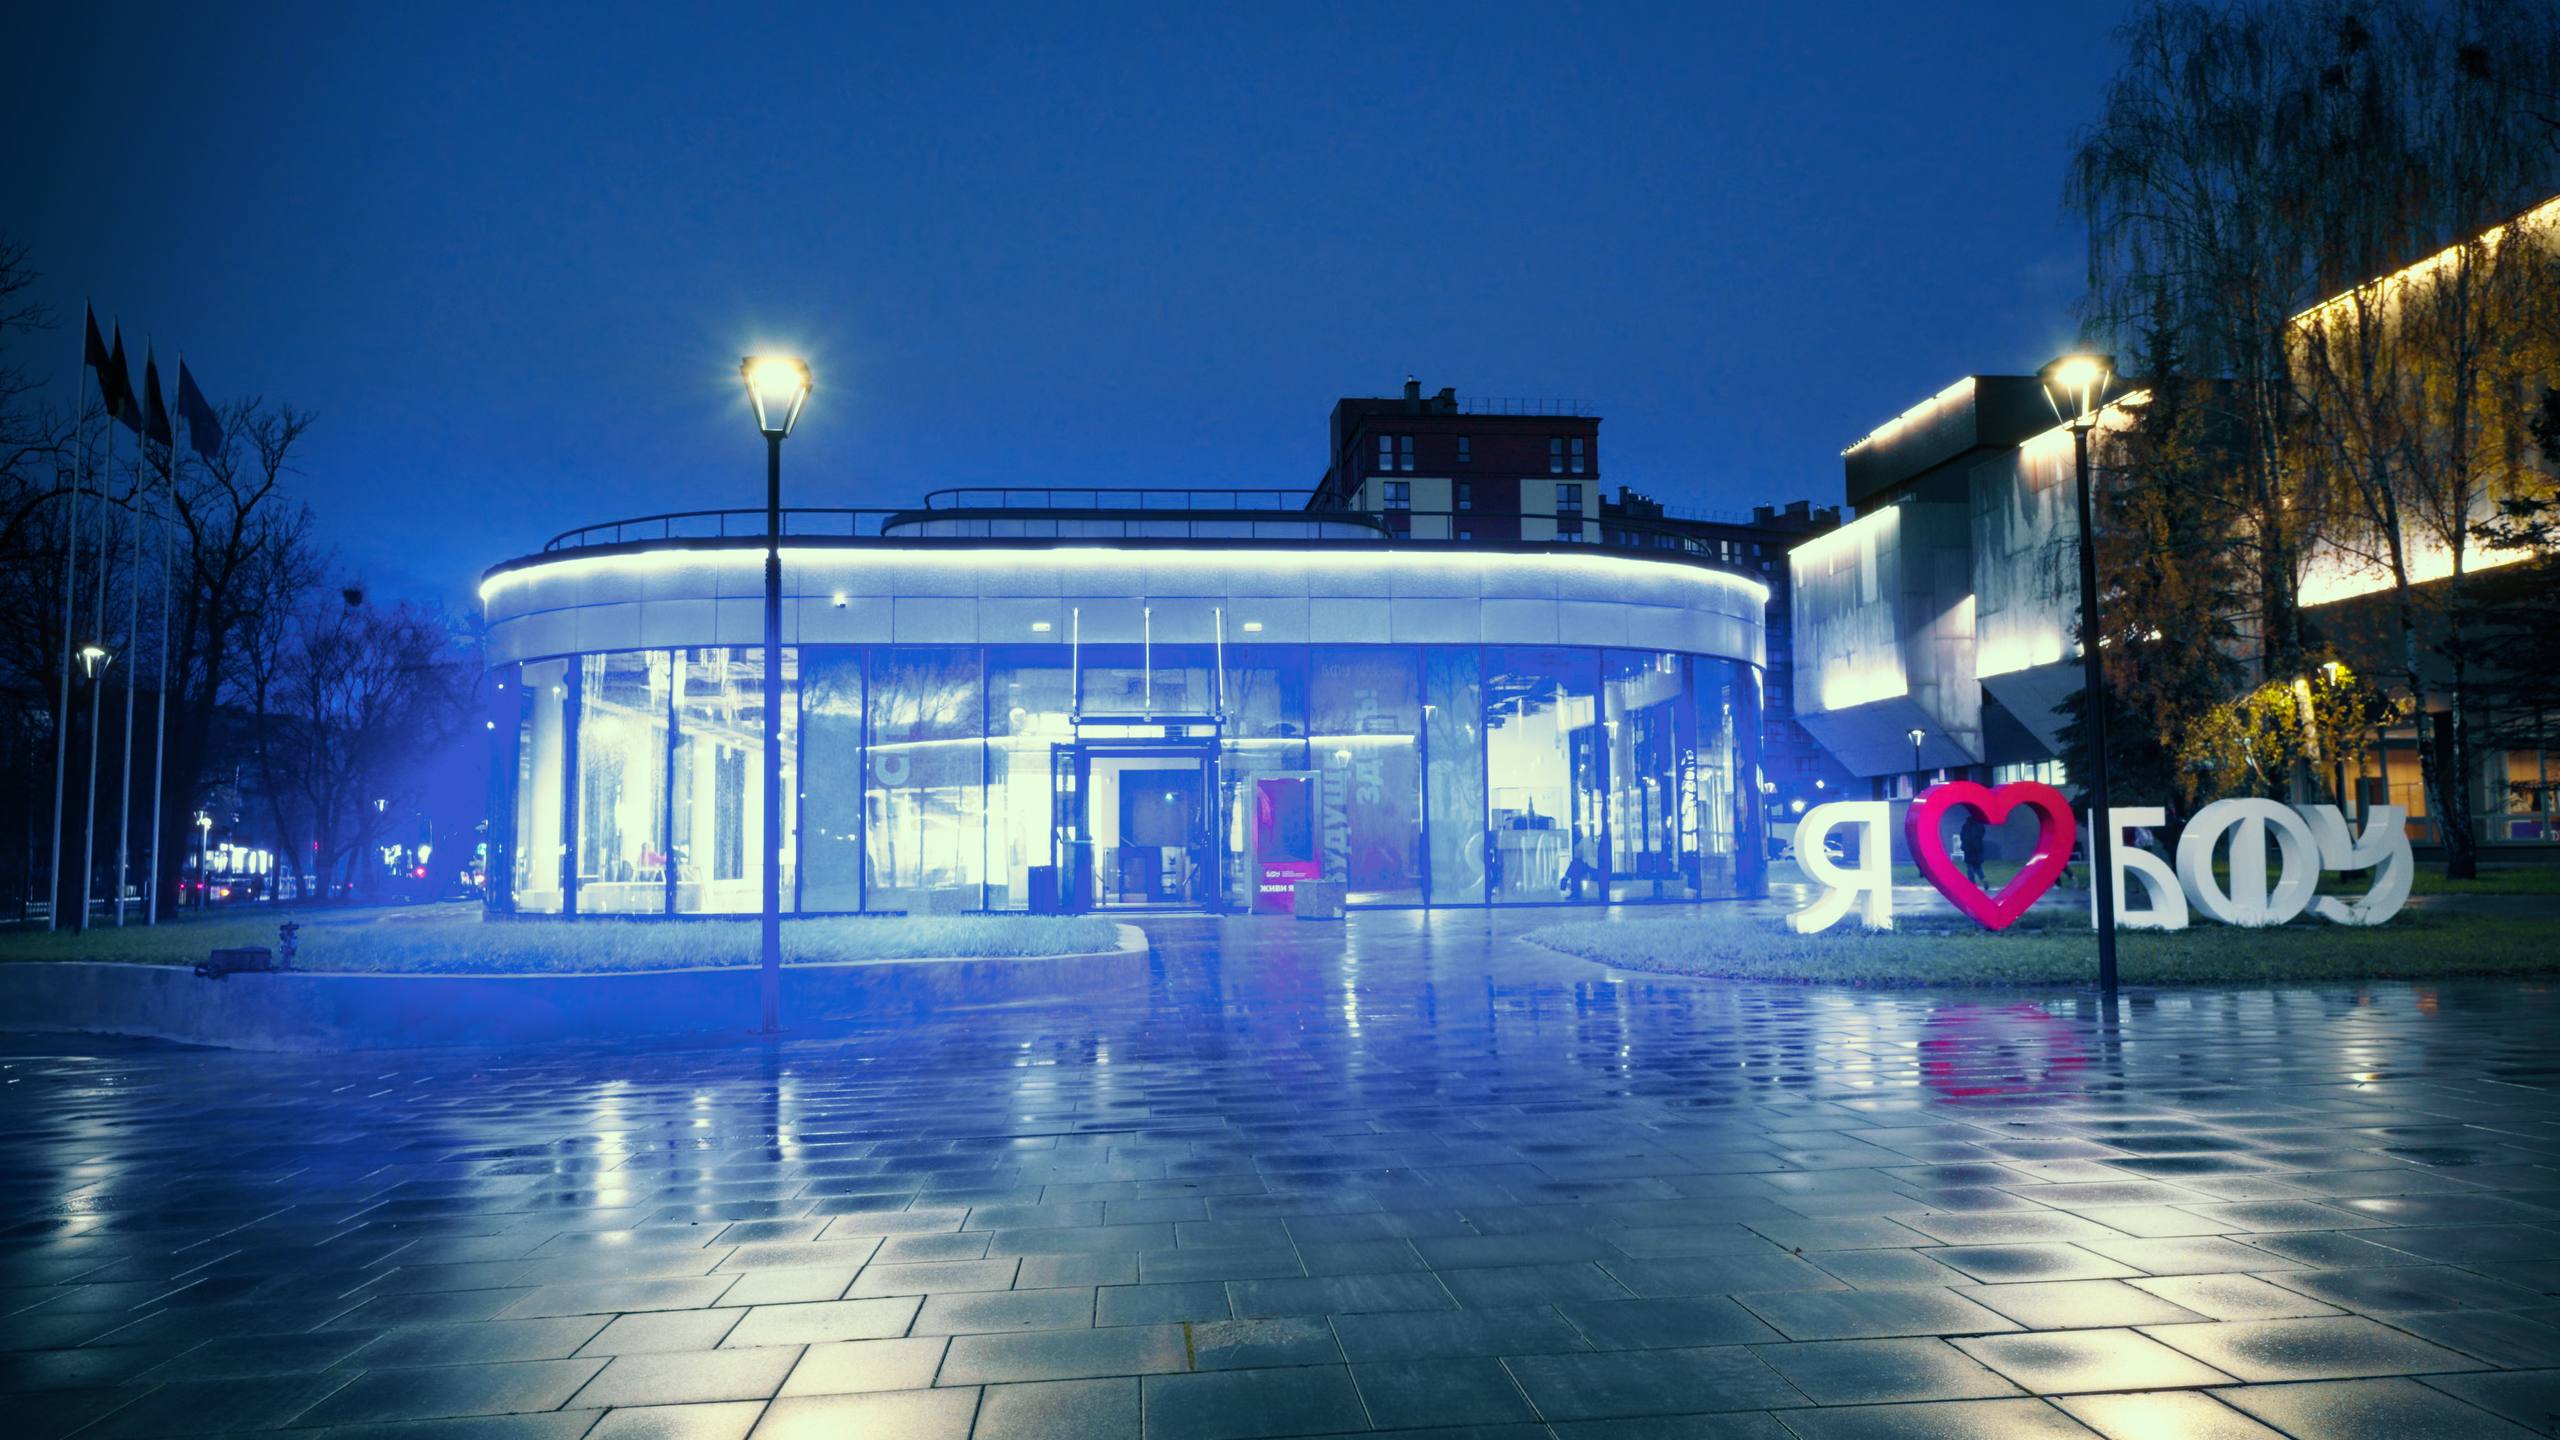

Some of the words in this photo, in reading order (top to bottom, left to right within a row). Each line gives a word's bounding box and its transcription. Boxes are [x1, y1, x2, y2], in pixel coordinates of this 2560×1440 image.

[1355, 689, 1384, 805] ЗДЕЬ!
[1323, 739, 1351, 883] УДУЩЕ
[1786, 800, 1893, 933] Я
[2088, 797, 2414, 930] БФУ
[1259, 884, 1287, 893] ЖИВИ
